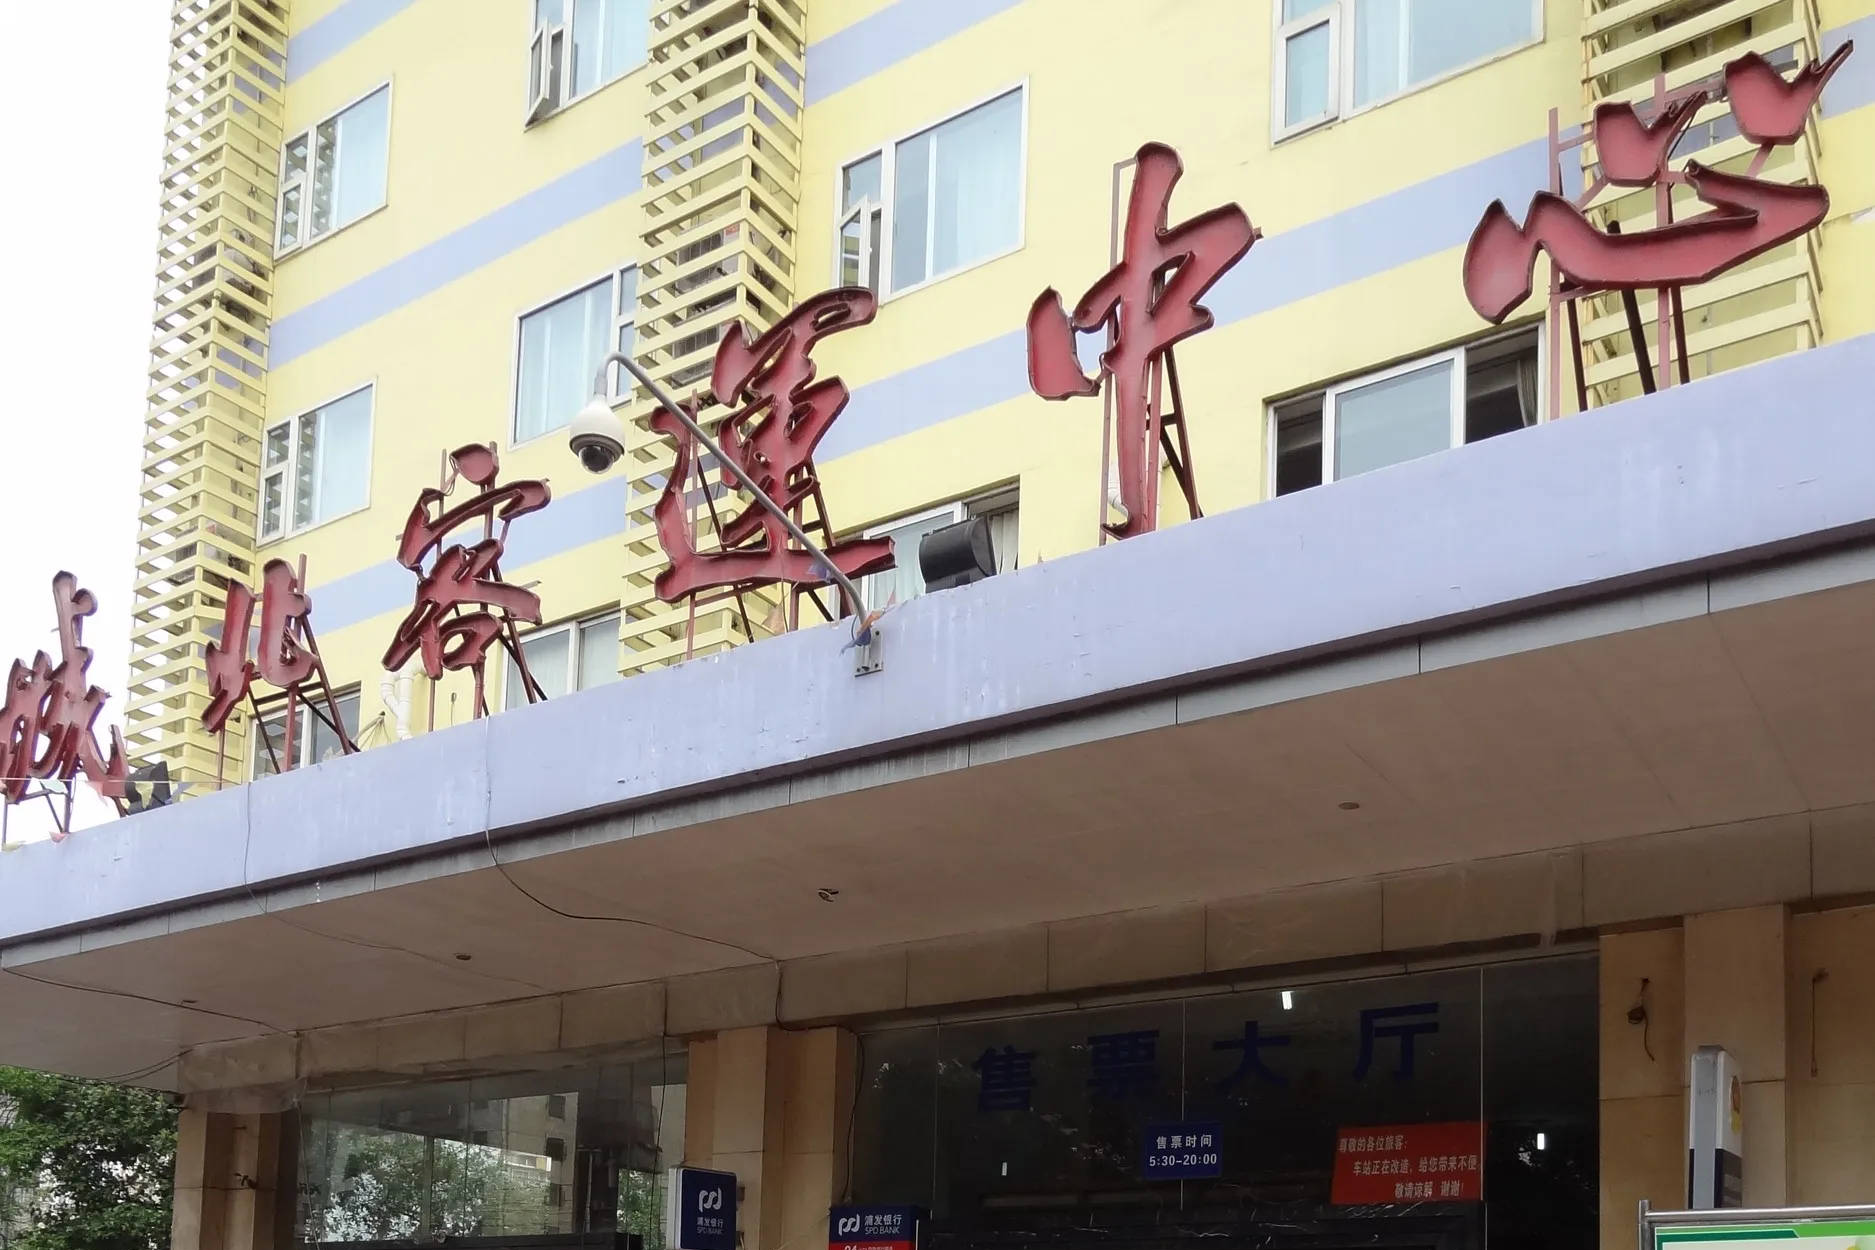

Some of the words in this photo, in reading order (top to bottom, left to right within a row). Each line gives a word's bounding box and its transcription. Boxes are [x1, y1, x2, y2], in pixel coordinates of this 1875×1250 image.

[972, 1003, 1439, 1111] 售票大厅
[1156, 1134, 1212, 1149] 售票时间
[1149, 1153, 1217, 1167] 5:30-20:00
[864, 1214, 902, 1226] 浦发银行
[865, 1227, 878, 1235] SPD
[880, 1226, 900, 1235] BANK
